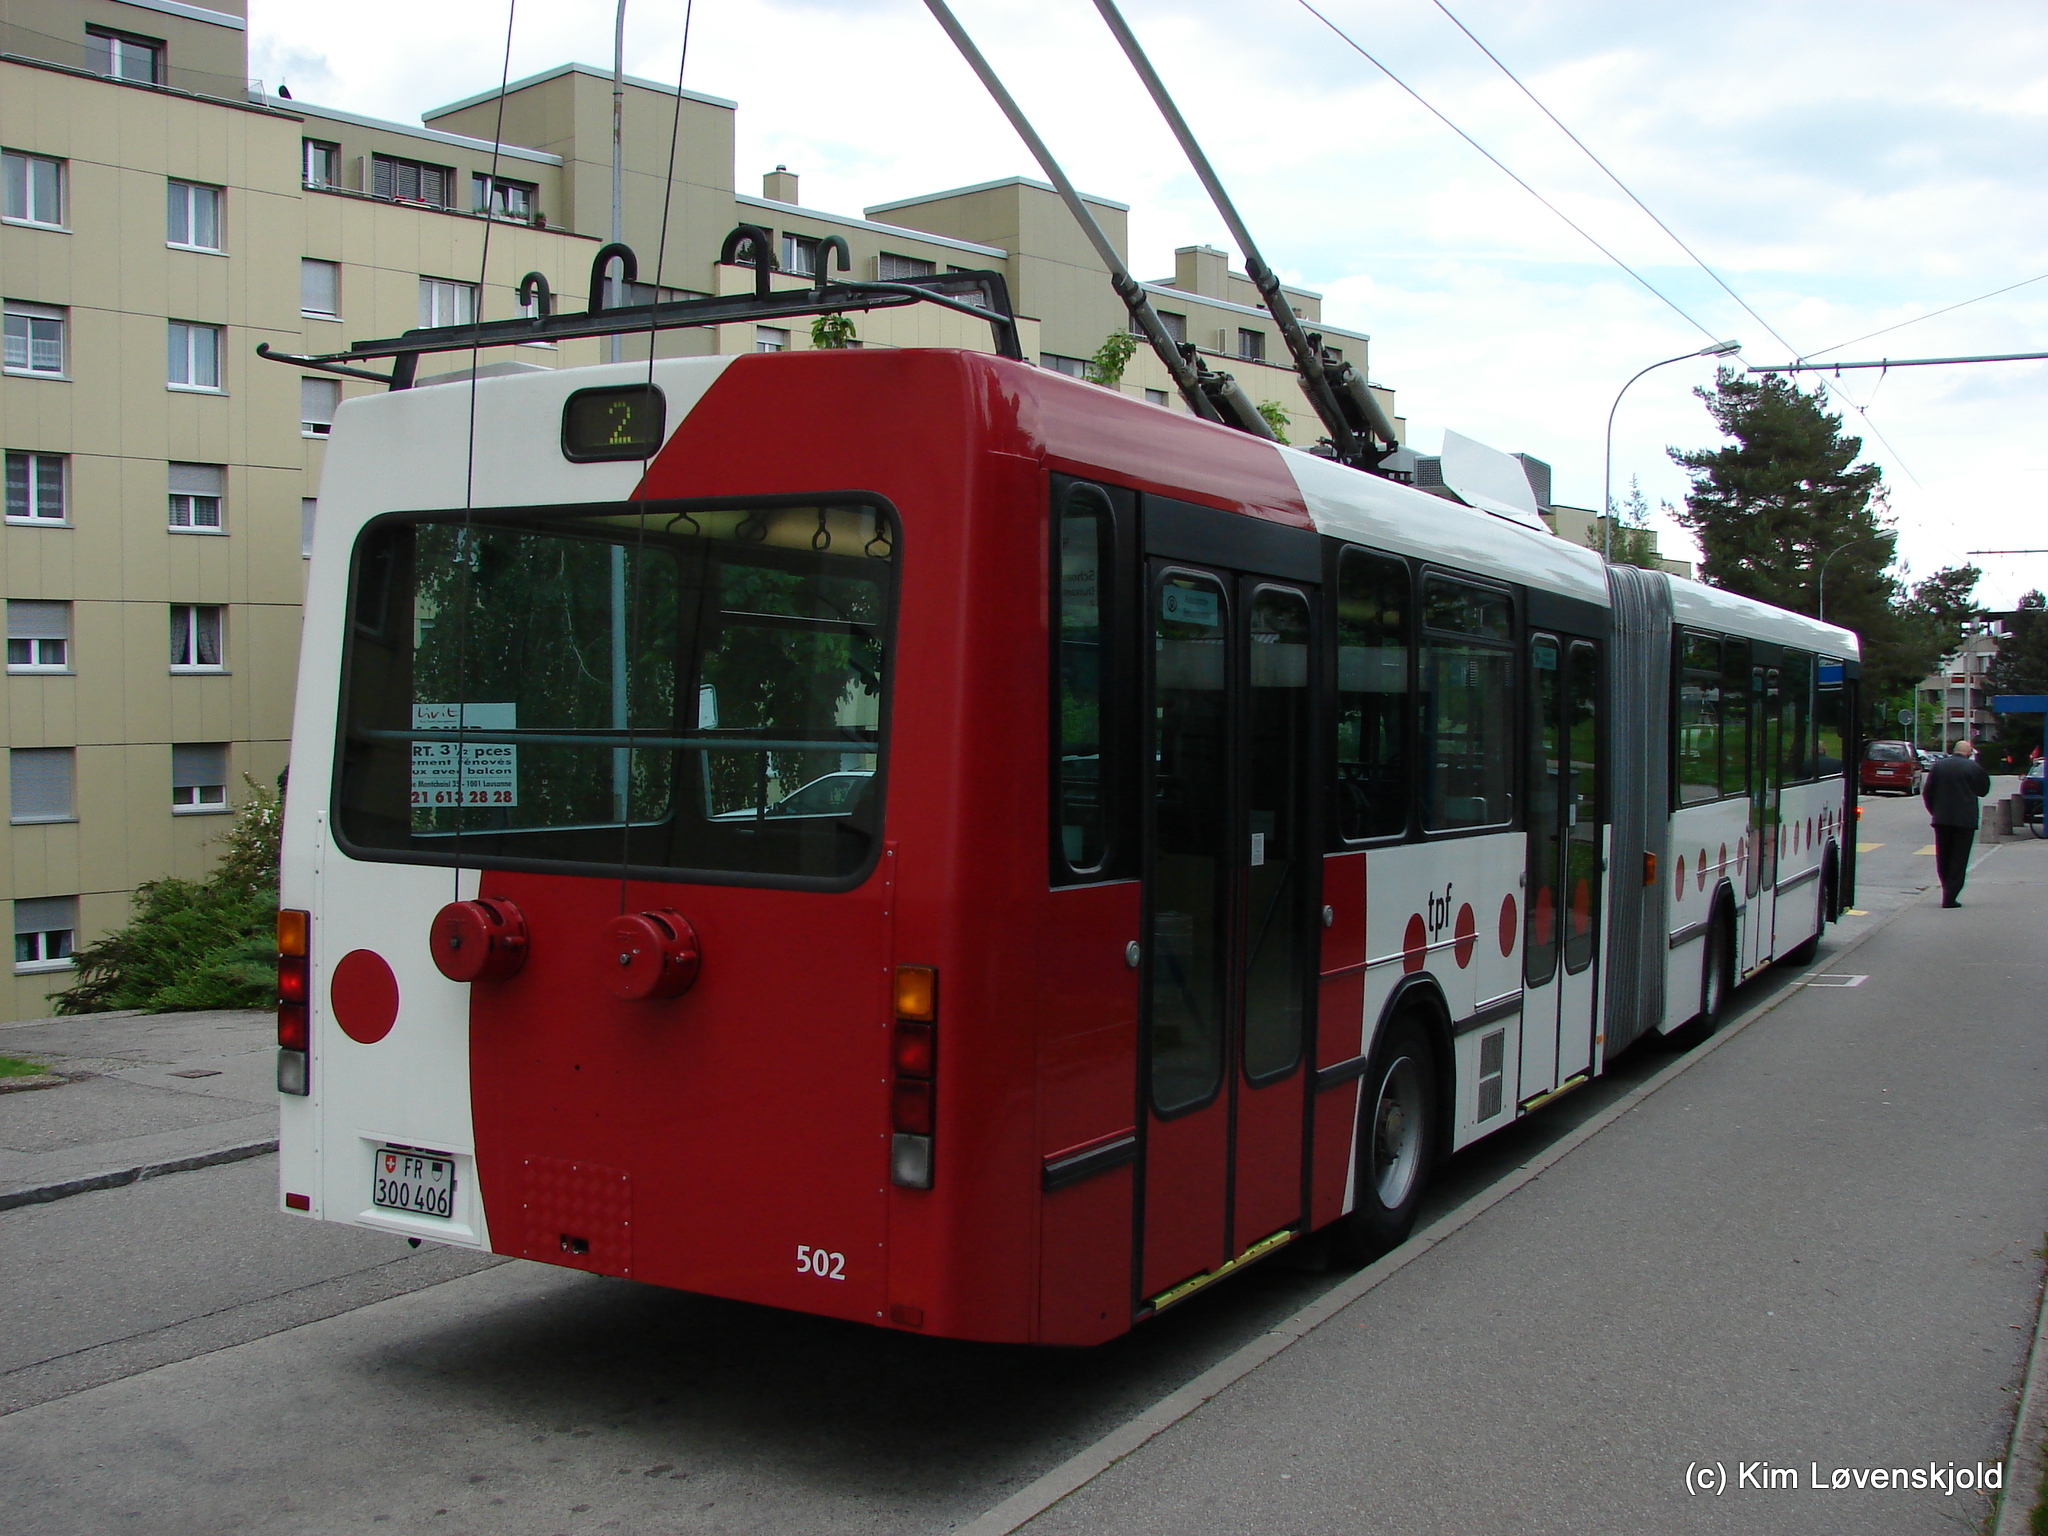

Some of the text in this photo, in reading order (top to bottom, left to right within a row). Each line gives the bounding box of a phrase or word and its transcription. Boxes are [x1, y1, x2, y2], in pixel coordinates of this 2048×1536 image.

[608, 402, 632, 444] 2
[412, 746, 434, 757] RT.
[440, 744, 451, 755] 3
[475, 748, 512, 758] pces
[467, 767, 512, 775] balcon
[467, 780, 481, 788] 1001
[411, 790, 513, 803] 21 613 28 28
[1428, 882, 1453, 942] tpf
[404, 1157, 424, 1180] FR
[376, 1178, 448, 1214] 300 406
[796, 1244, 846, 1281] 502
